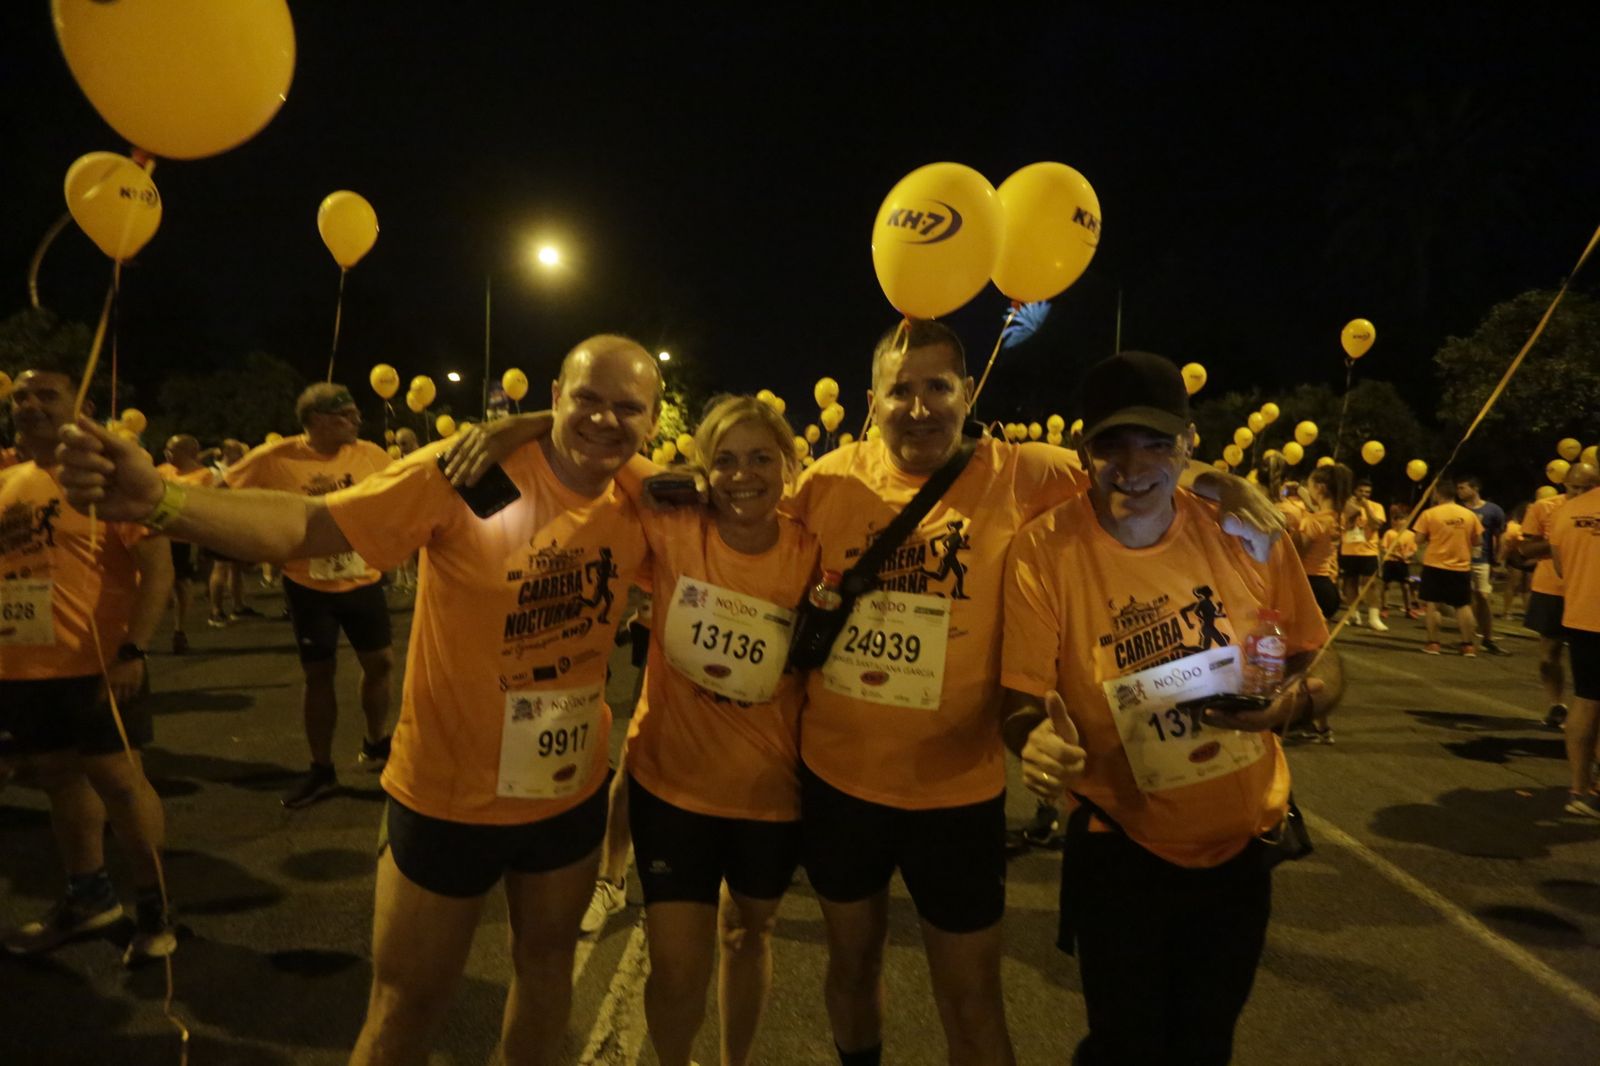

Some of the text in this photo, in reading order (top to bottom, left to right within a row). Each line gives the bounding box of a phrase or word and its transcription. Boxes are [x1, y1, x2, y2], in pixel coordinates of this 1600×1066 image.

[518, 569, 583, 605] CARRERA
[504, 602, 583, 638] NOCTURNA
[690, 620, 767, 665] 13136
[844, 626, 921, 663] 24939
[1114, 616, 1184, 669] CARRERA
[538, 722, 589, 757] 9917
[1148, 708, 1187, 741] 13
